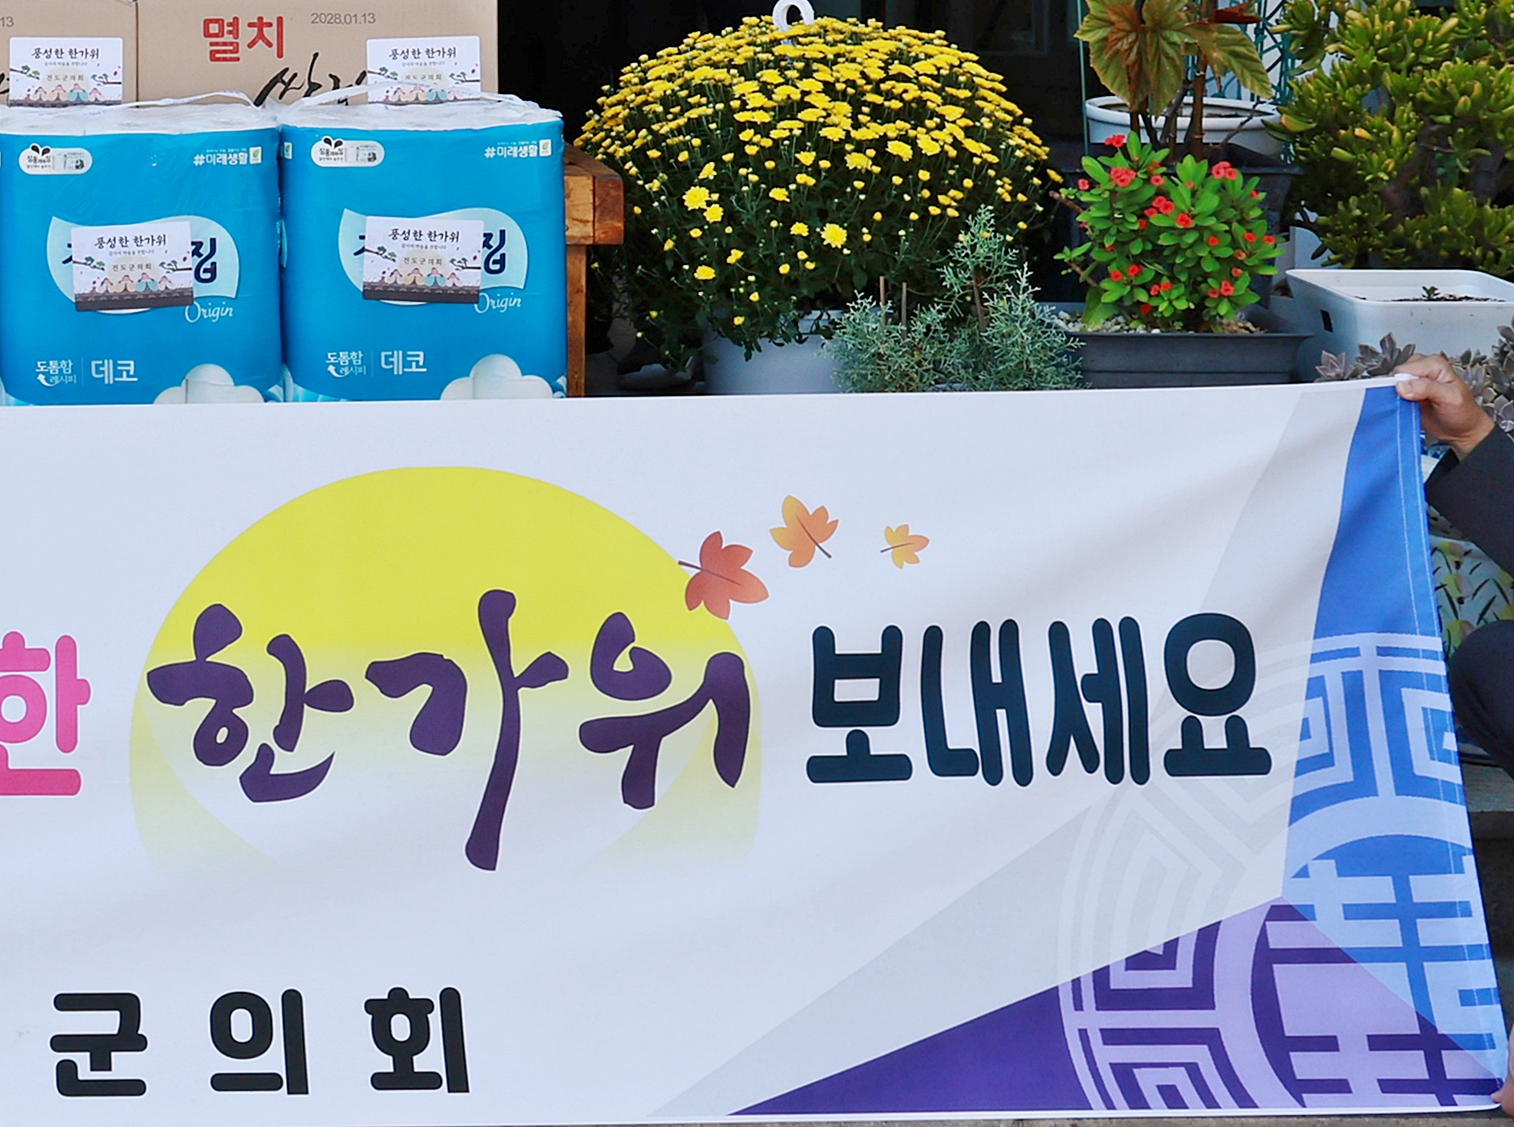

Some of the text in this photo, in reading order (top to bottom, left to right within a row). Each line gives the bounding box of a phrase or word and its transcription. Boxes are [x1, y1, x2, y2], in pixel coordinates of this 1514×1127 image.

[202, 12, 376, 63] 멸치 2028.01.13
[31, 47, 100, 60] 풍성한 한가위
[389, 47, 457, 60] 풍성한 한가위
[193, 152, 249, 166] #미래생활
[484, 145, 538, 158] #미래생활
[94, 234, 167, 249] 풍성한 한가위
[388, 228, 460, 243] 풍성한 한가위
[473, 292, 522, 314] Origin
[184, 300, 234, 323] Origin
[326, 350, 428, 375] 도톰함 데코
[35, 359, 138, 385] 도톰함 데코
[339, 366, 367, 376] 레시피
[49, 374, 77, 384] 레시피
[146, 590, 750, 873] 한가위
[806, 611, 1272, 787] 보내세요
